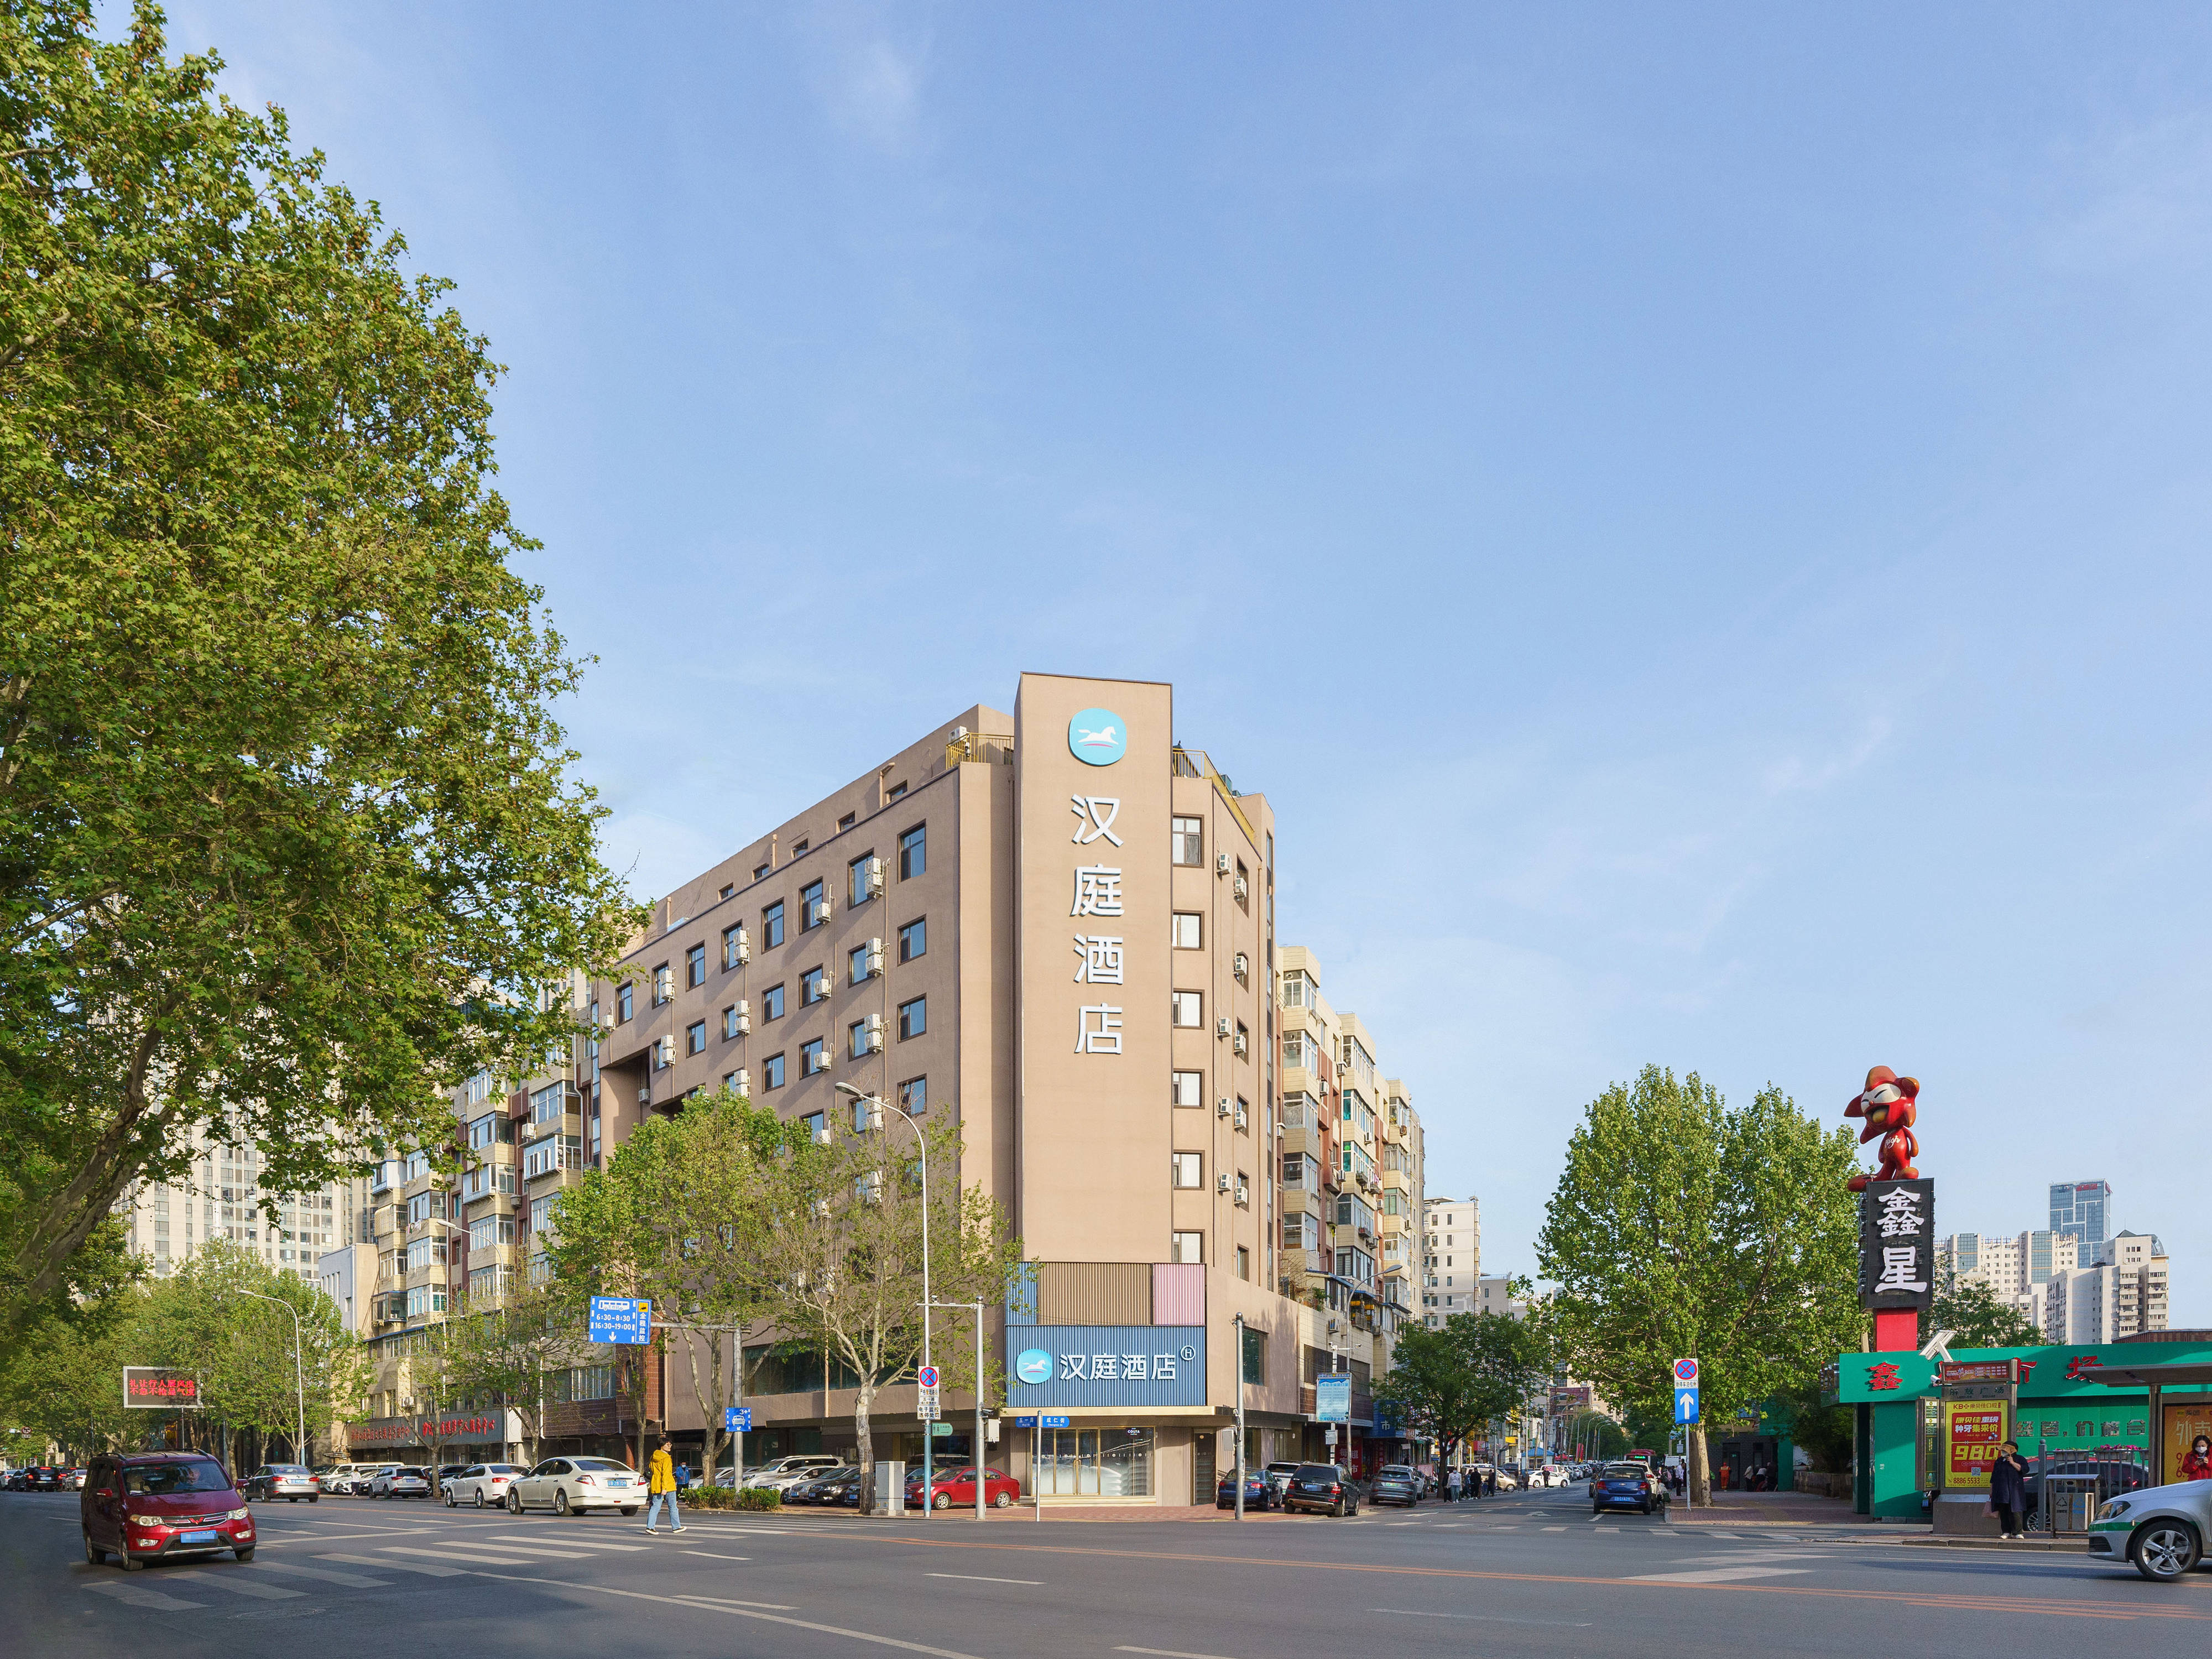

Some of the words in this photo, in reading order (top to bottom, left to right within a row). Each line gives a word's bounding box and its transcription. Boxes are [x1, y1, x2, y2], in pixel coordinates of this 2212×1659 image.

[1071, 794, 1125, 1054] 汉庭酒店
[1875, 1187, 1927, 1293] 鑫星
[1060, 1353, 1176, 1380] 汉庭酒店
[1955, 1424, 1998, 1433] 种牙集采价
